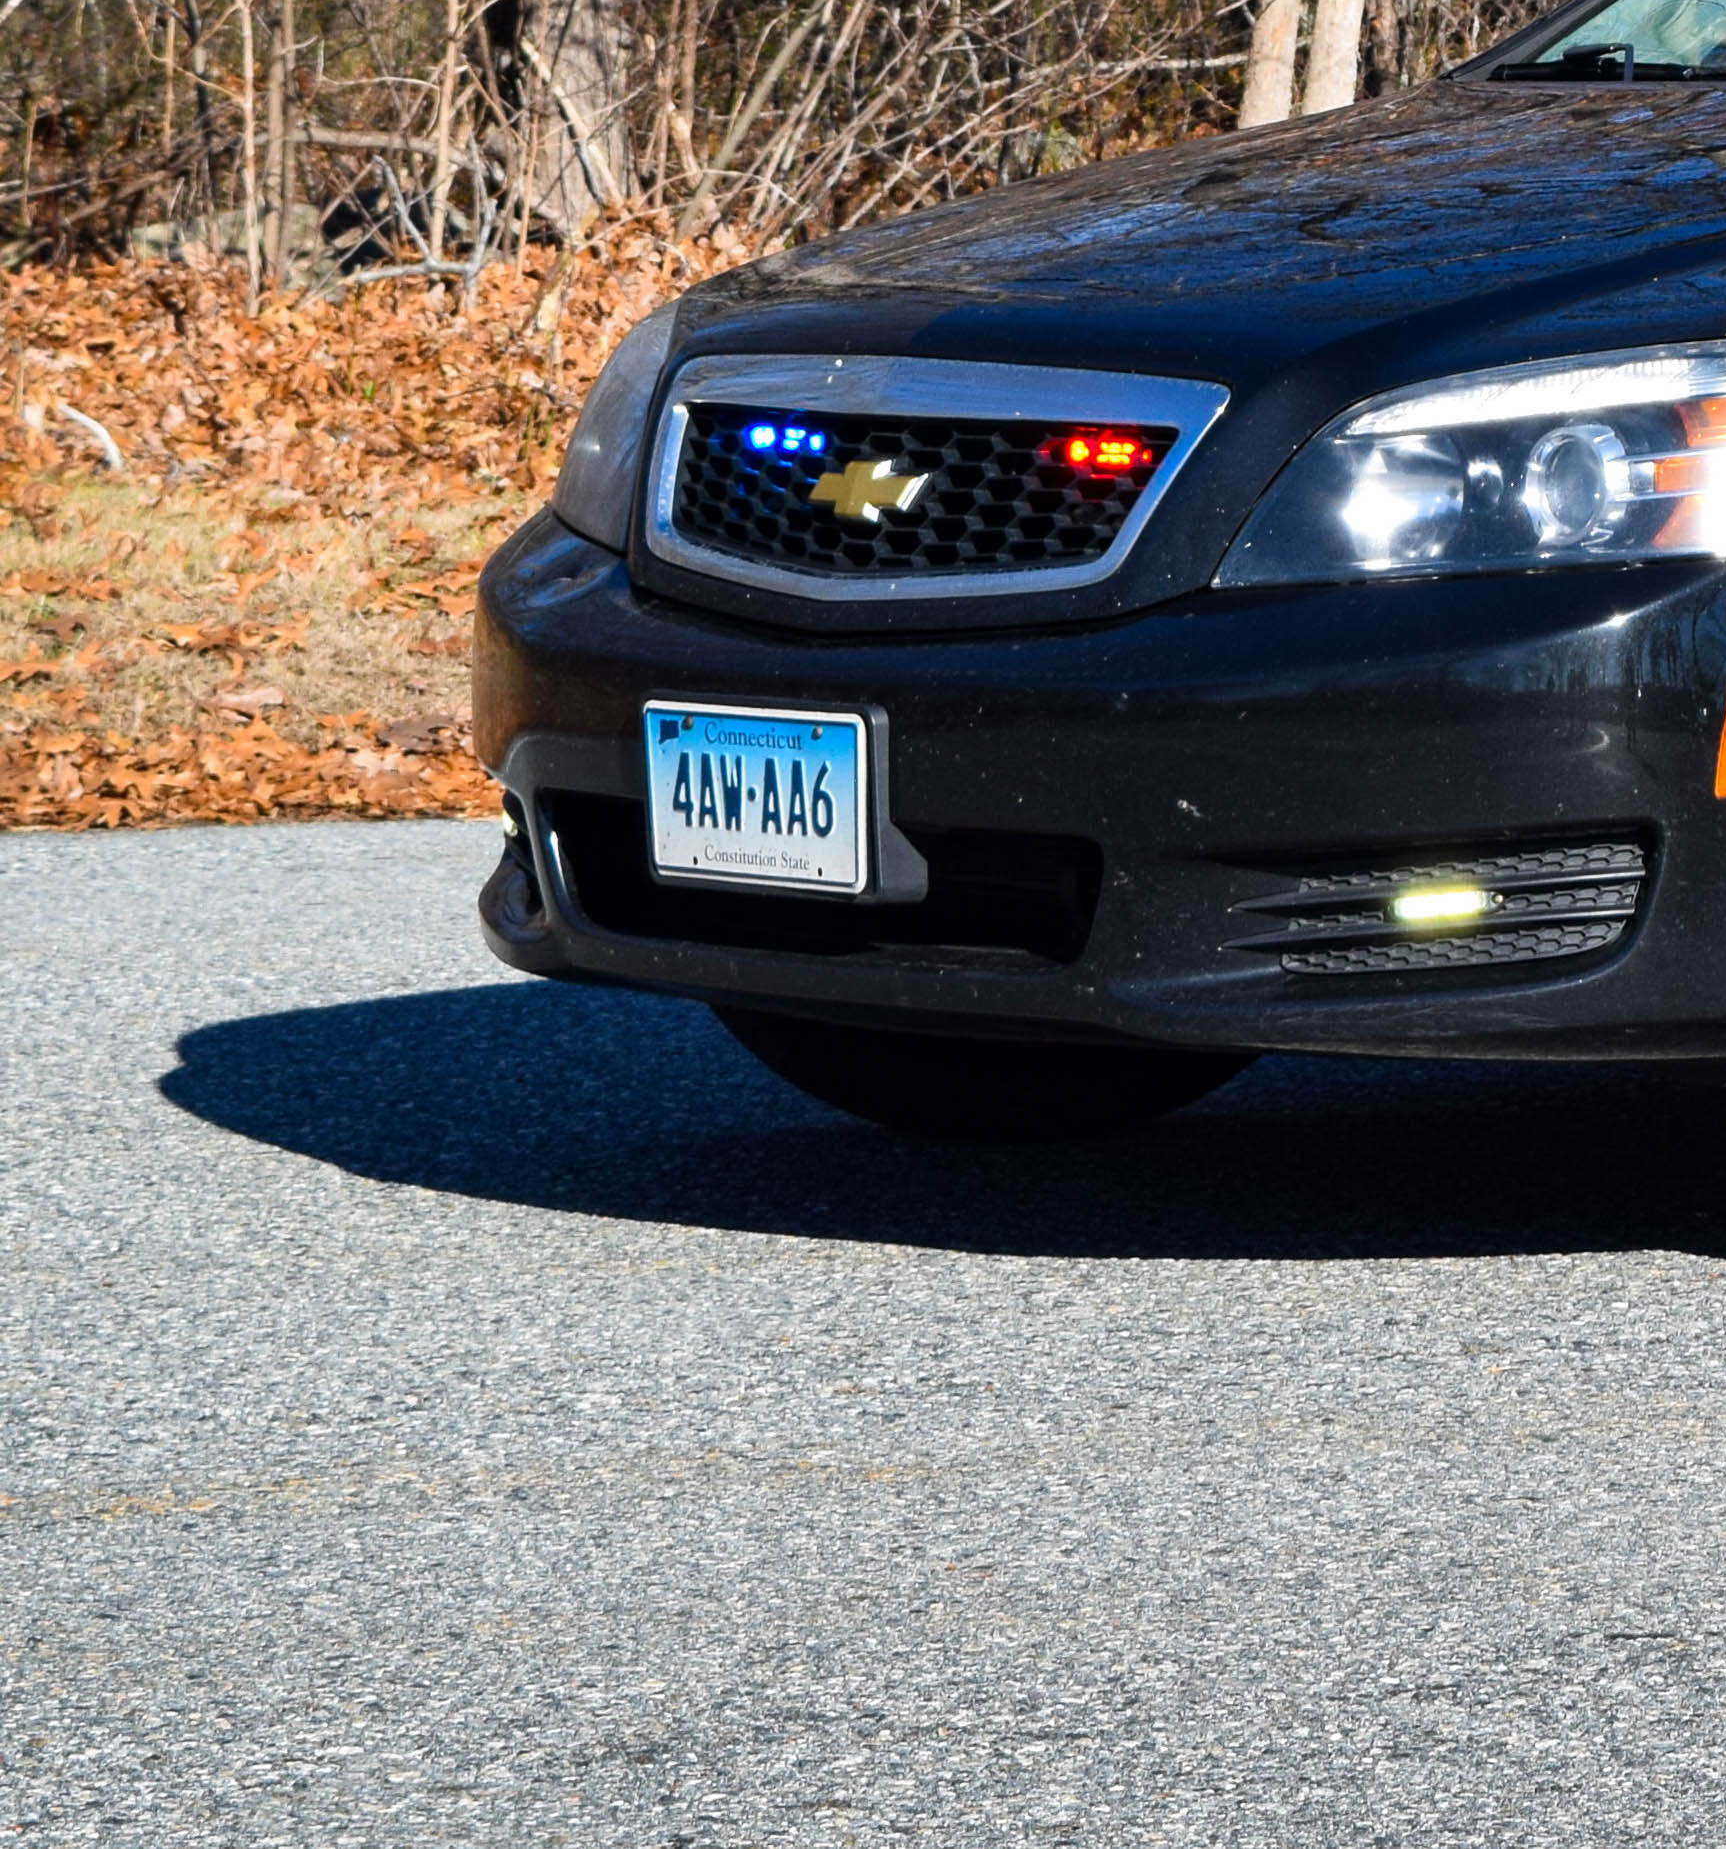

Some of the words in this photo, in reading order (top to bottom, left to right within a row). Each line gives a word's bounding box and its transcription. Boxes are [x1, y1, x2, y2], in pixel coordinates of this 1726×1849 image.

[704, 722, 803, 750] Connecticut
[704, 844, 777, 868] Constitution
[780, 852, 810, 871] State
